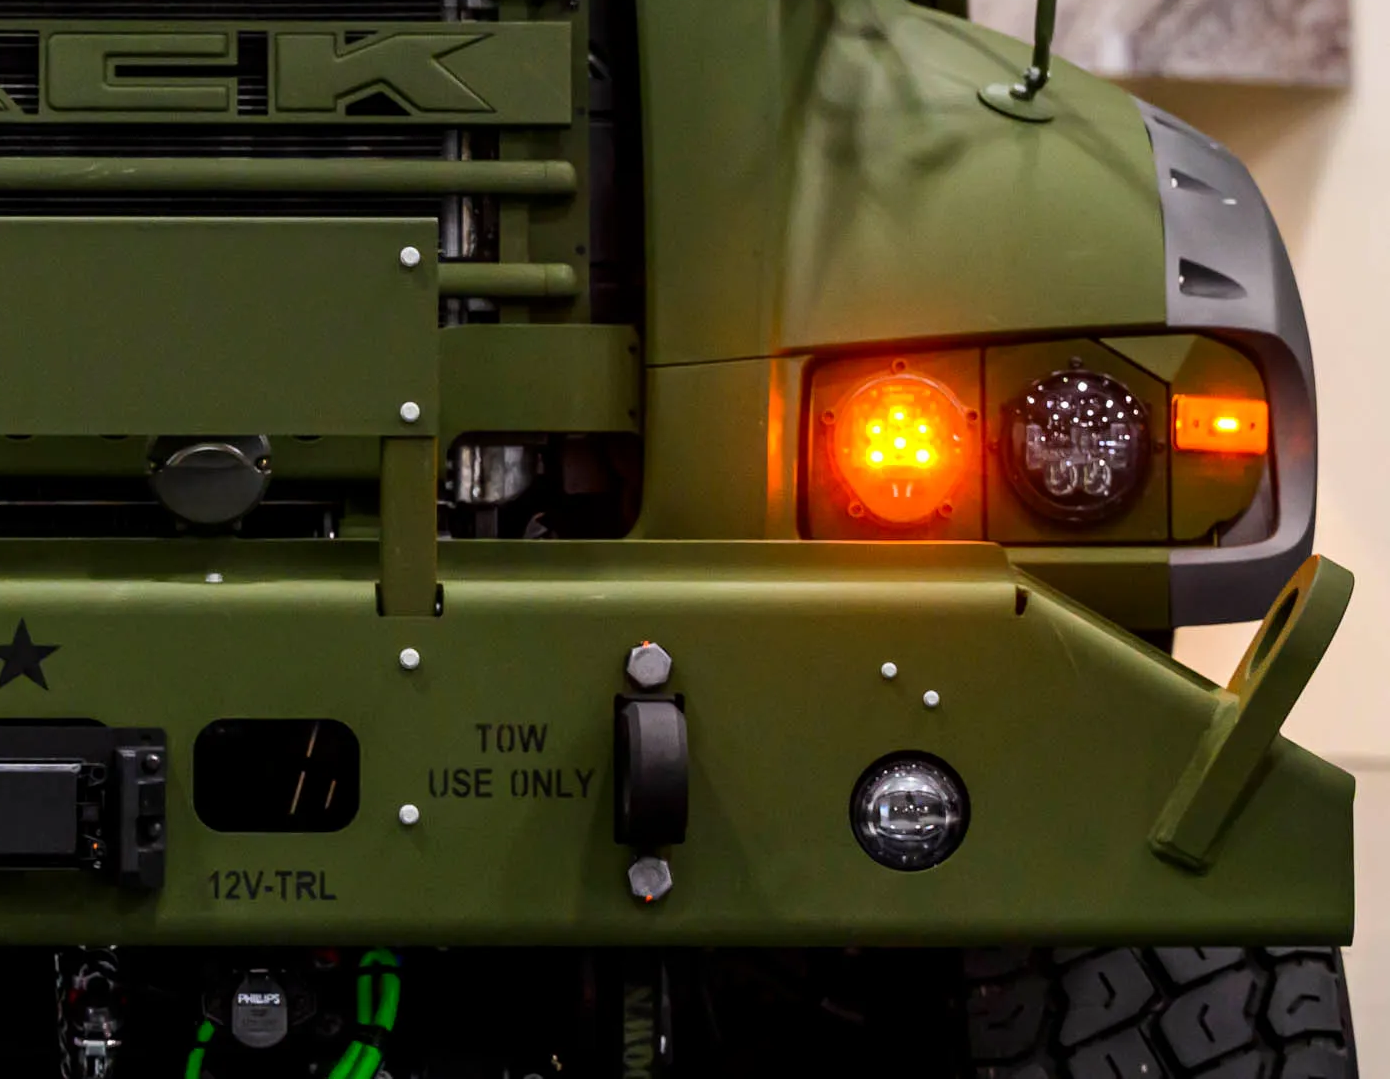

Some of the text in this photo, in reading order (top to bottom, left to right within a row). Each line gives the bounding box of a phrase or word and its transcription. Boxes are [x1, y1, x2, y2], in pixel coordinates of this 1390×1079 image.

[476, 723, 548, 754] TOW
[428, 768, 595, 798] USE ONLY
[209, 870, 338, 901] 12V-TRL
